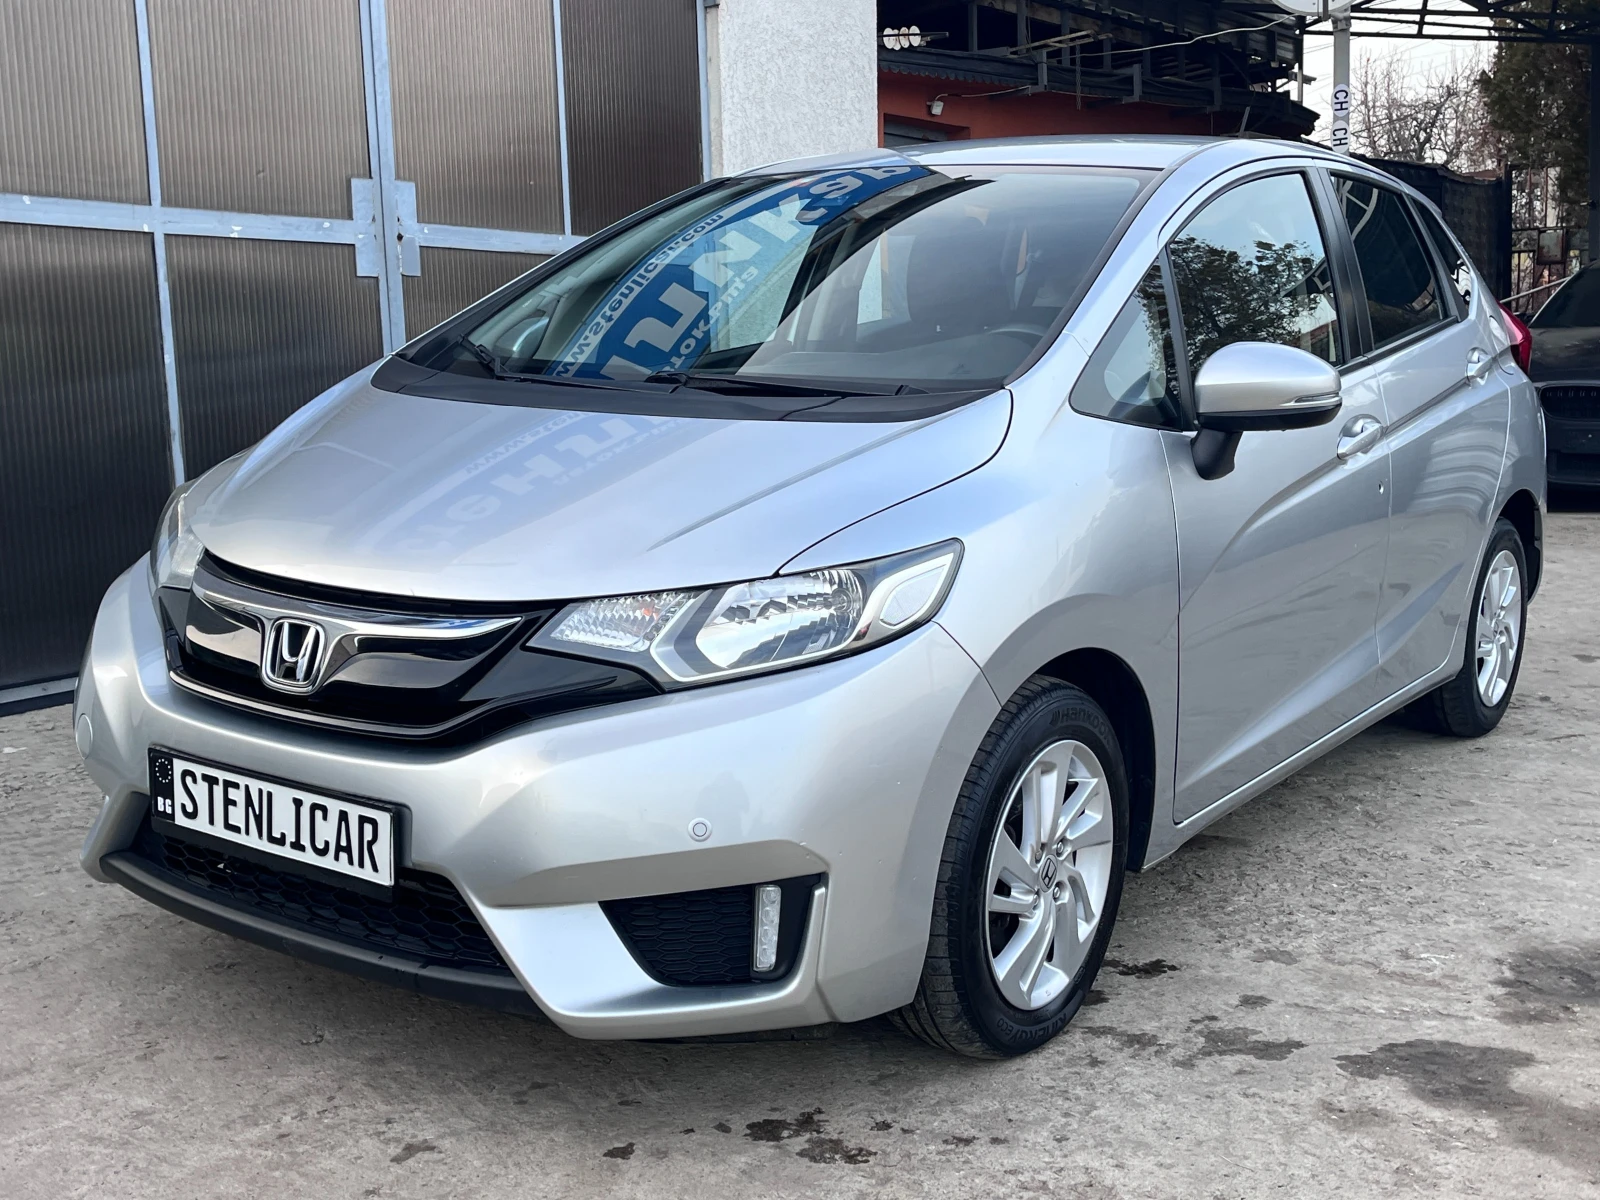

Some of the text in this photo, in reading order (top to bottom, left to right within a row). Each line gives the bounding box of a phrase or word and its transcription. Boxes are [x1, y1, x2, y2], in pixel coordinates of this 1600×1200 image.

[1333, 89, 1349, 112] CH
[1332, 127, 1348, 147] CH
[156, 795, 173, 815] BG
[180, 768, 380, 874] STENLICAR
